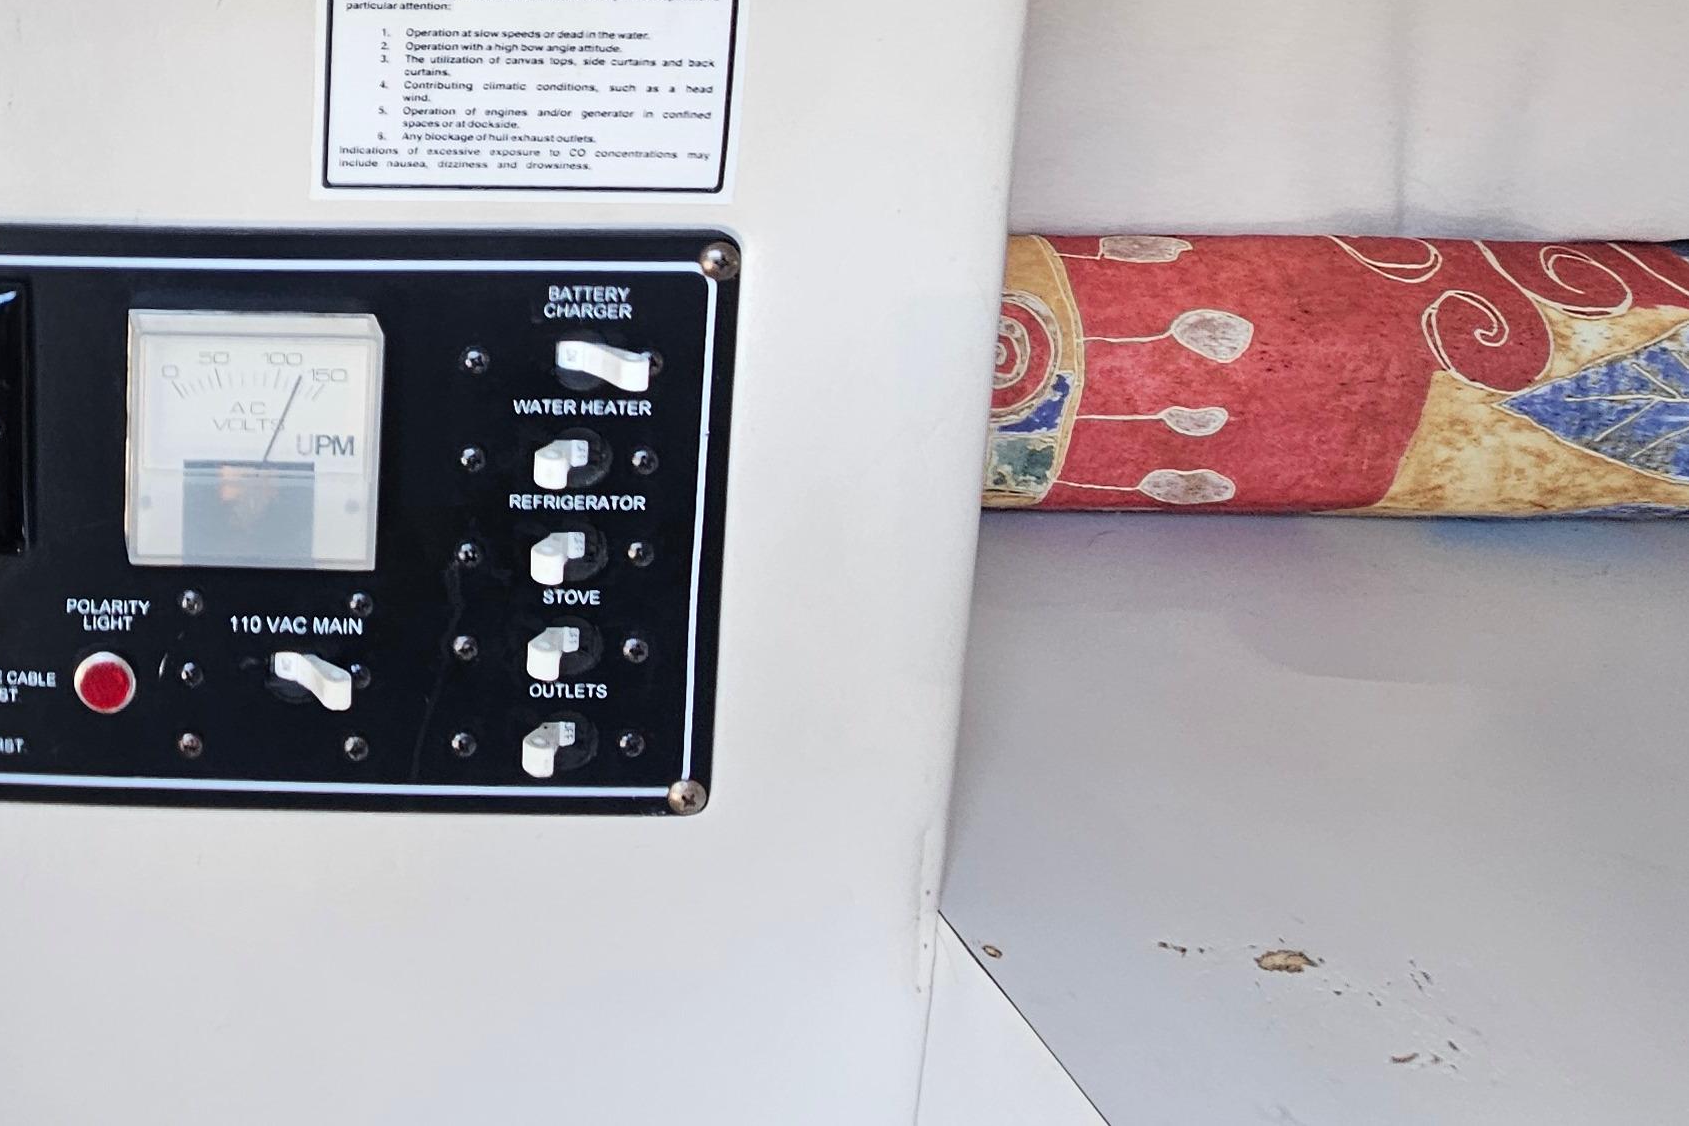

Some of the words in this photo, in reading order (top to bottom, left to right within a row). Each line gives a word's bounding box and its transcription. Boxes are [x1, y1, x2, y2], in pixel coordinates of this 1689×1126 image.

[406, 28, 459, 39] Operation
[461, 29, 472, 37] at
[474, 29, 499, 37] slow
[501, 30, 541, 39] speeds
[544, 31, 555, 39] or
[557, 30, 583, 39] dead
[585, 31, 596, 39] in
[598, 31, 616, 39] the
[617, 32, 650, 40] water.
[405, 42, 459, 52] Operation
[461, 42, 483, 51] with
[495, 43, 518, 53] high
[521, 43, 544, 52] bow
[546, 45, 576, 54] angle
[578, 45, 622, 53] attitude.
[405, 55, 425, 64] The
[430, 55, 483, 64] utilization
[489, 56, 500, 64] of
[505, 57, 544, 65] canvas
[549, 57, 577, 67] tops,
[583, 57, 606, 66] side
[611, 58, 656, 67] curtains
[662, 58, 683, 67] and
[688, 59, 715, 68] back
[404, 68, 451, 76] curtains.
[549, 285, 631, 302] BATTERY
[543, 303, 632, 320] CHARGER
[198, 351, 230, 365] 50
[263, 352, 303, 366] 100
[161, 364, 179, 379] 0
[310, 368, 348, 382] 150
[513, 399, 577, 415] WATER
[581, 400, 652, 416] HEATER
[212, 418, 285, 432] VOLTS
[296, 433, 355, 456] UPM
[509, 494, 646, 511] REFRIGERATOR
[543, 589, 601, 605] STOVE
[66, 598, 150, 616] POLARITY
[83, 615, 133, 632] LIGHT
[230, 615, 262, 634] 110
[266, 616, 308, 635] VAC
[313, 616, 363, 636] MAIN
[6, 671, 56, 688] CABLE
[529, 683, 608, 699] OUTLETS
